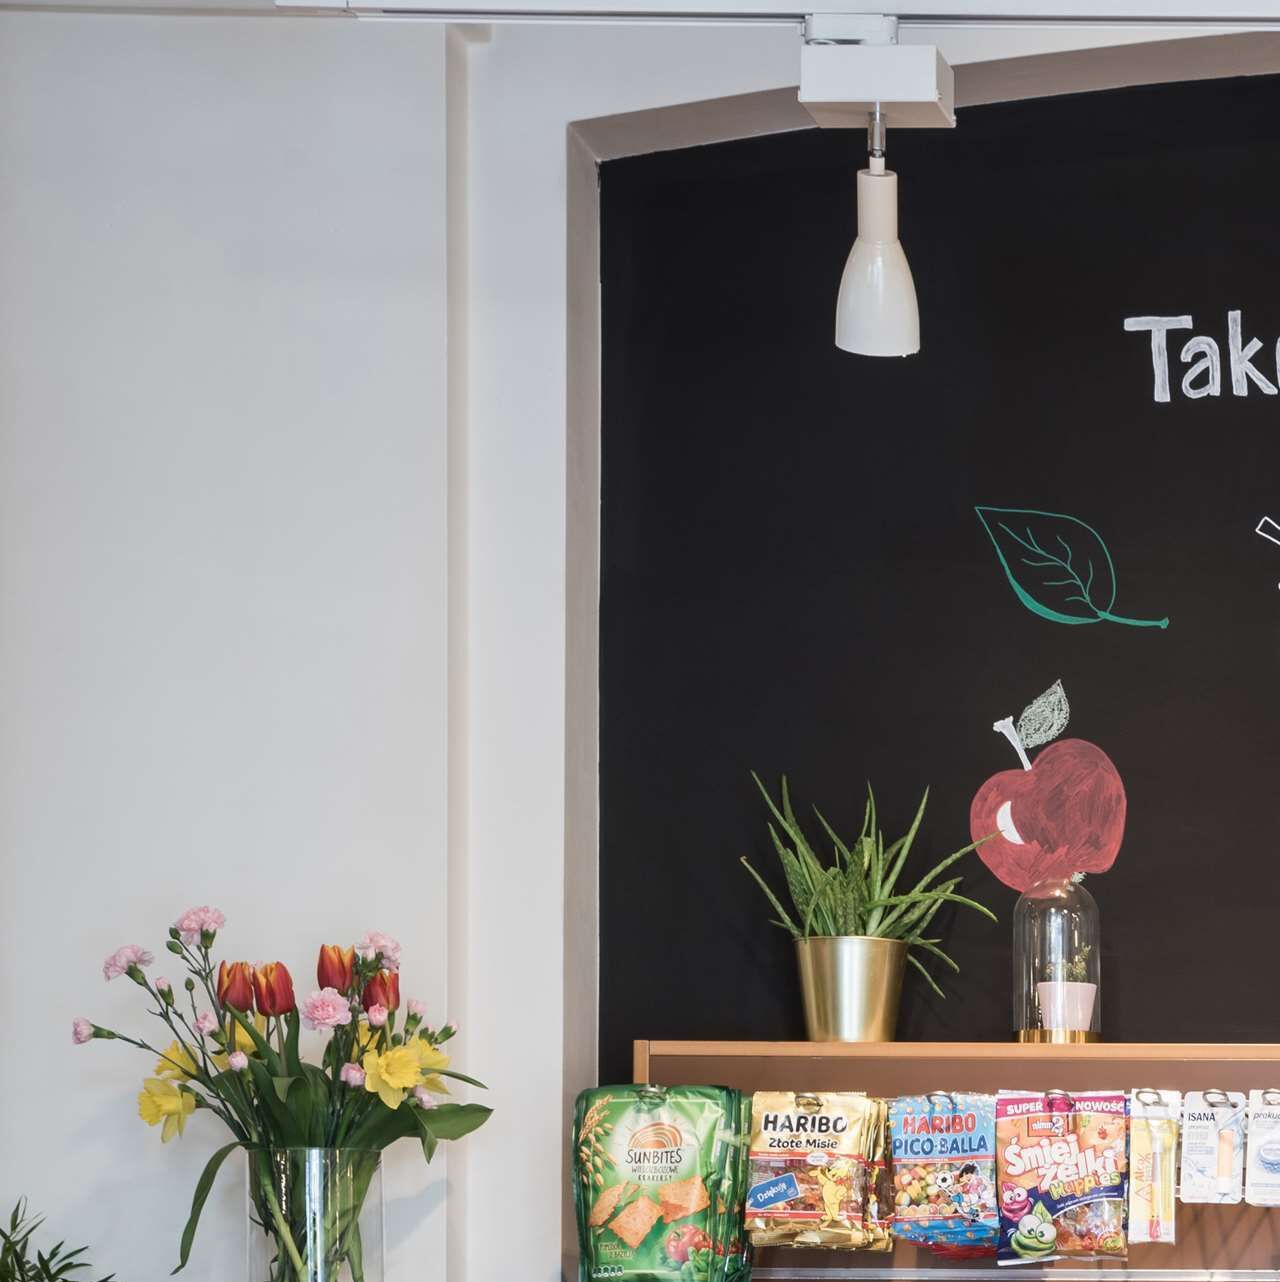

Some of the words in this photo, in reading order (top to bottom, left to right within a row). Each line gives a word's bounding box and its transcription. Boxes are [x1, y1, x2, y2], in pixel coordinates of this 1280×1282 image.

[1006, 1101, 1044, 1115] SUPER
[763, 1112, 848, 1135] HARIBO
[902, 1112, 977, 1136] HARIBO
[1188, 1112, 1216, 1122] ISANA
[768, 1137, 803, 1150] Złote
[805, 1138, 839, 1150] Misie
[626, 1149, 683, 1165] SUNBITES
